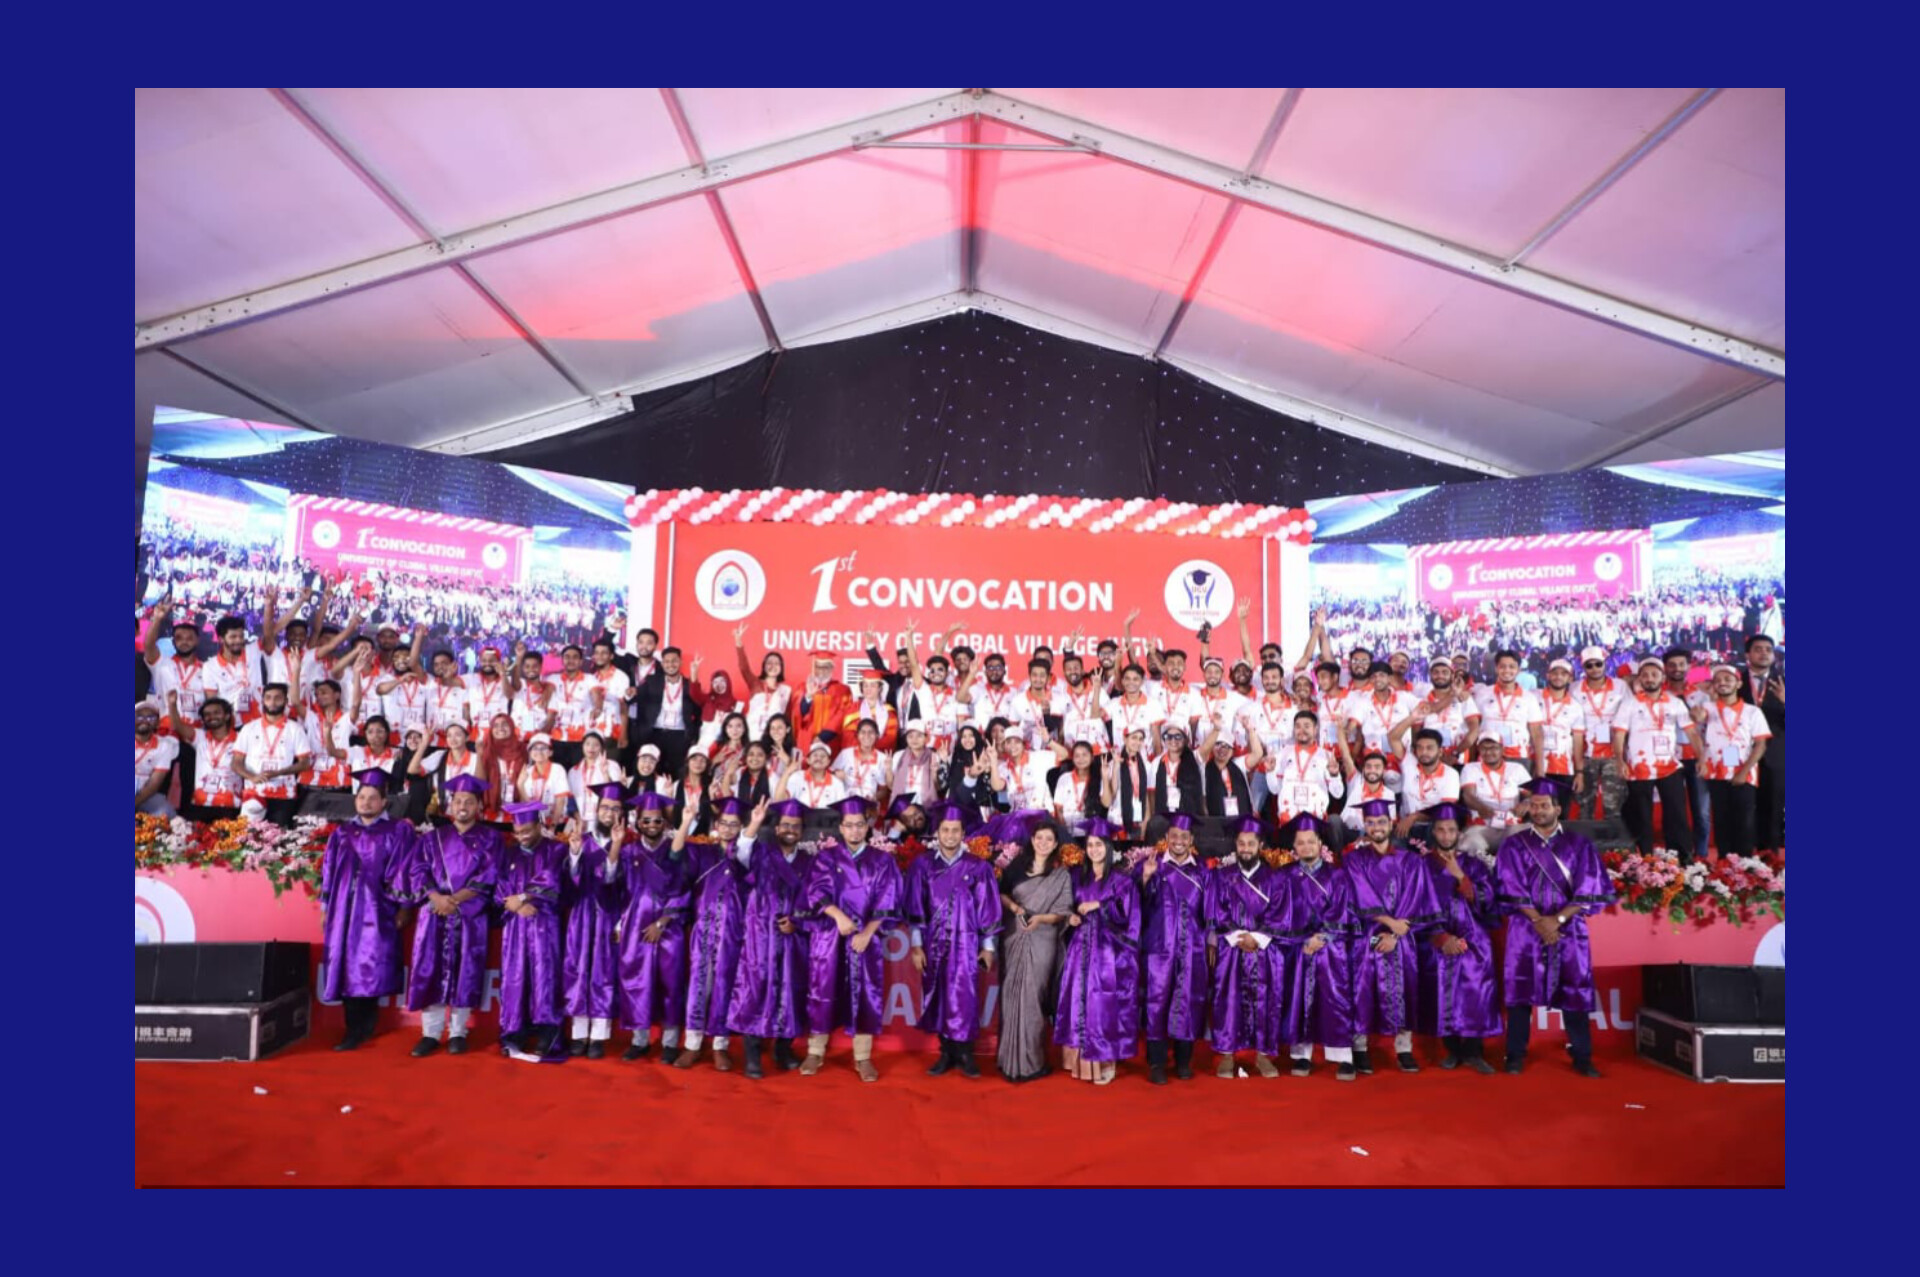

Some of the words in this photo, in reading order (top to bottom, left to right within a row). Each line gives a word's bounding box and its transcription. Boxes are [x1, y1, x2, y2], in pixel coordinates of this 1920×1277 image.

[370, 536, 466, 559] CONVOCATION
[810, 549, 858, 613] 1st
[848, 576, 1113, 612] CONVOCATION
[1480, 564, 1576, 582] CONVOCATION
[763, 629, 890, 652] UNIVERSIY
[895, 631, 923, 651] OF
